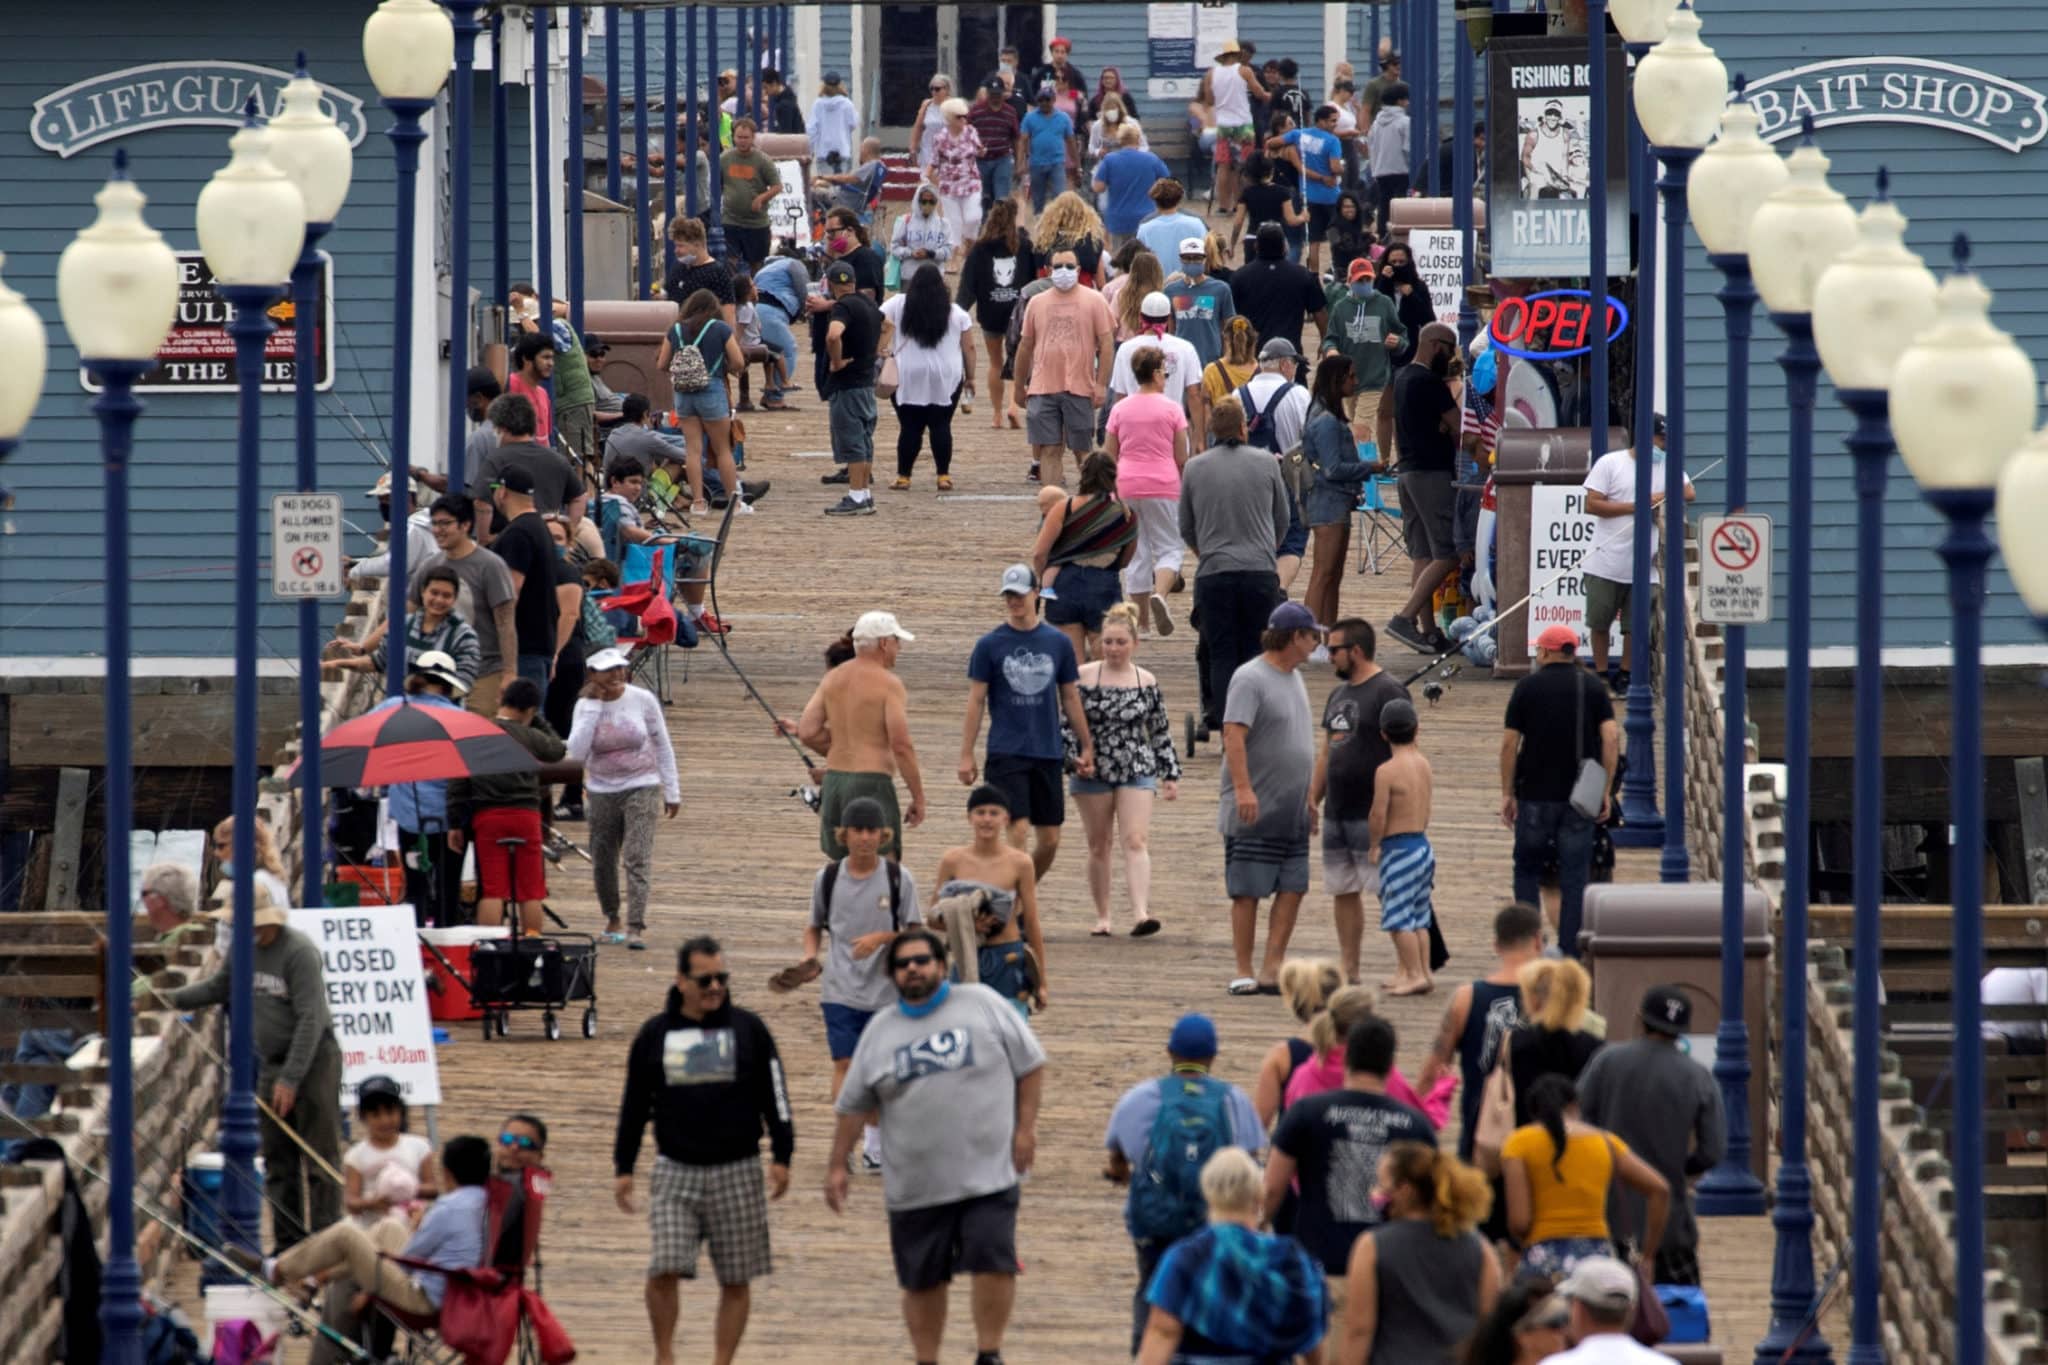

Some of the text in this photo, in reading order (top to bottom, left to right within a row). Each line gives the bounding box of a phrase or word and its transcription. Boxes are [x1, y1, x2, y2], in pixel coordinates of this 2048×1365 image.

[1511, 64, 1570, 89] FISHING
[1747, 72, 2014, 135] BAIT SHOP
[1512, 208, 1590, 246] RENTA
[1429, 236, 1455, 251] PIER
[1419, 255, 1463, 269] CLOSED
[1447, 273, 1463, 287] DA
[1431, 292, 1453, 306] OM
[165, 362, 297, 381] THE IE
[1550, 521, 1596, 542] CLOS
[1726, 574, 1745, 585] NO
[1707, 586, 1764, 598] SMOKING
[1709, 598, 1760, 609] ON PIER
[1534, 606, 1582, 625] 10:00pm
[322, 918, 374, 942] PIER
[323, 948, 396, 973] LOSED
[326, 980, 416, 1005] ERY DAY
